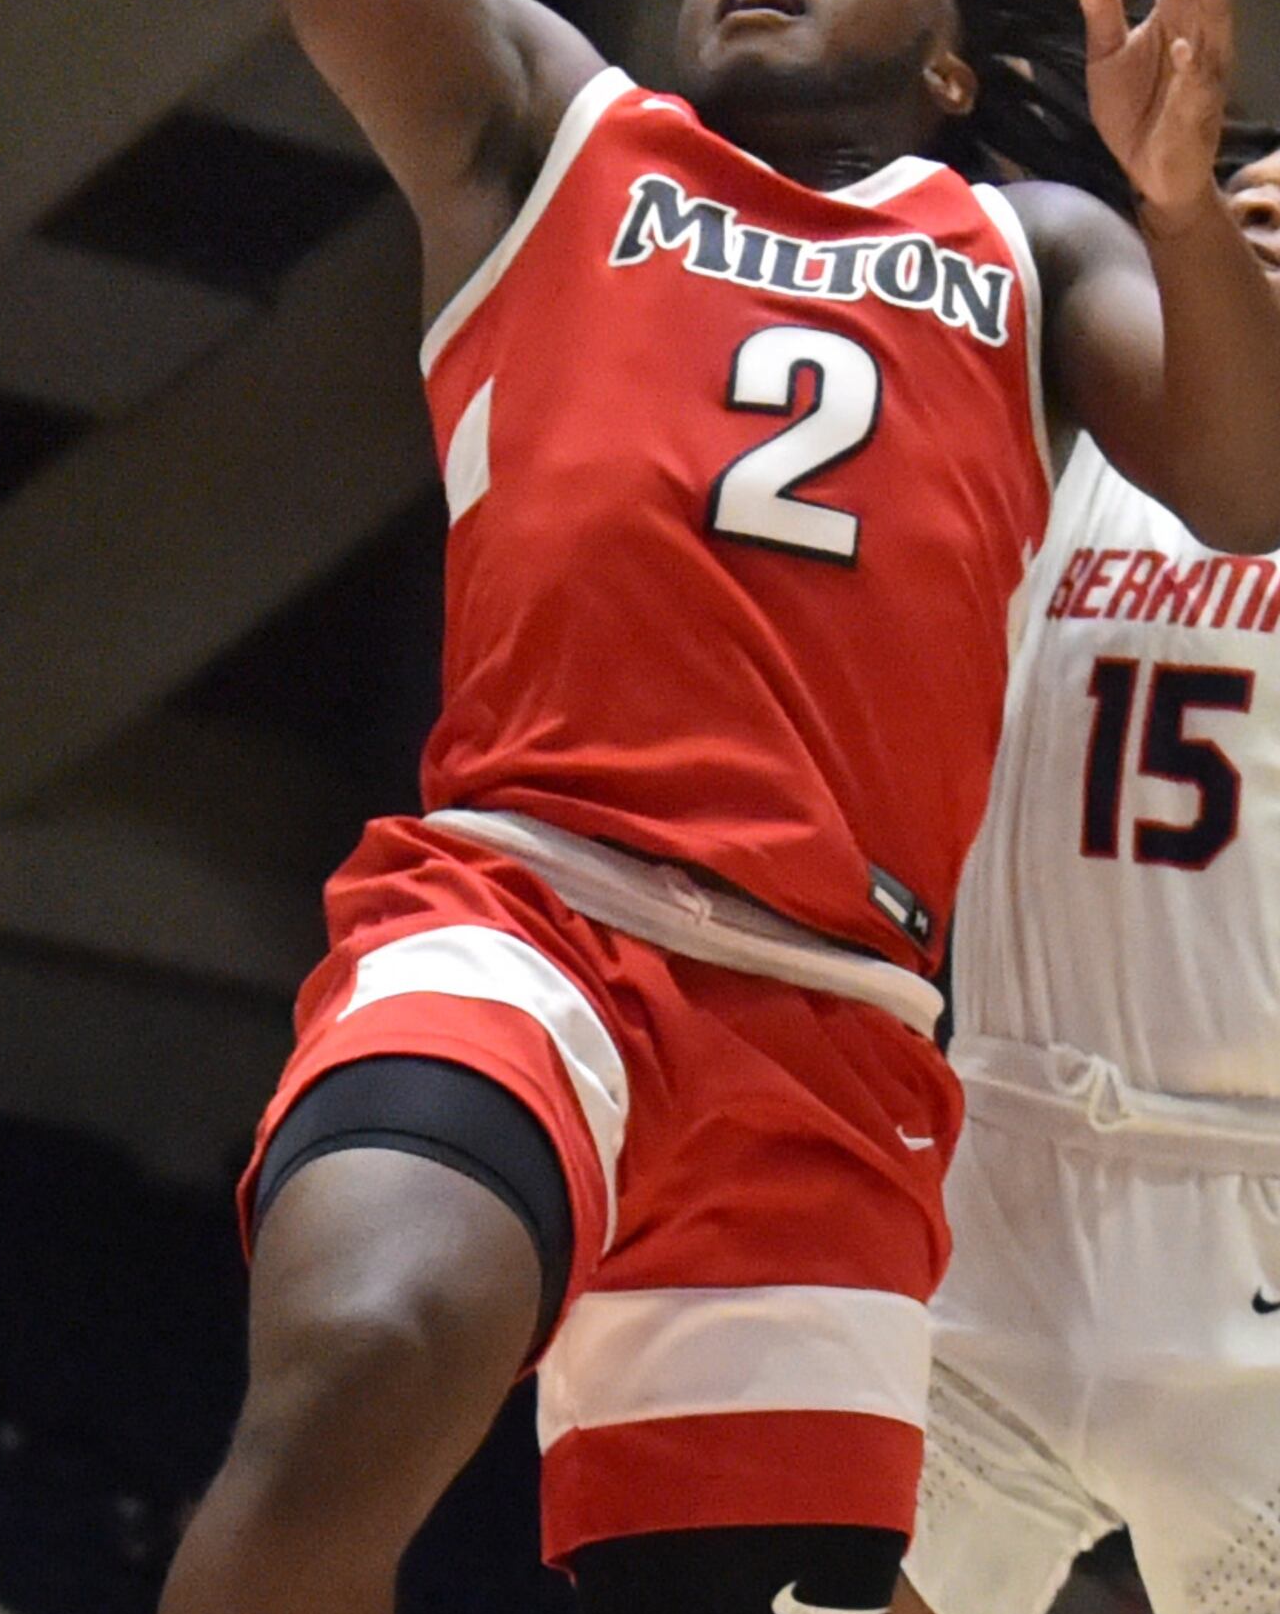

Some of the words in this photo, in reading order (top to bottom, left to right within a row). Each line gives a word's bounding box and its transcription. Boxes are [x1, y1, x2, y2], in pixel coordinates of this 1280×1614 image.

[608, 173, 1015, 347] MILTON
[708, 323, 883, 569] 2
[1080, 655, 1256, 873] 15
